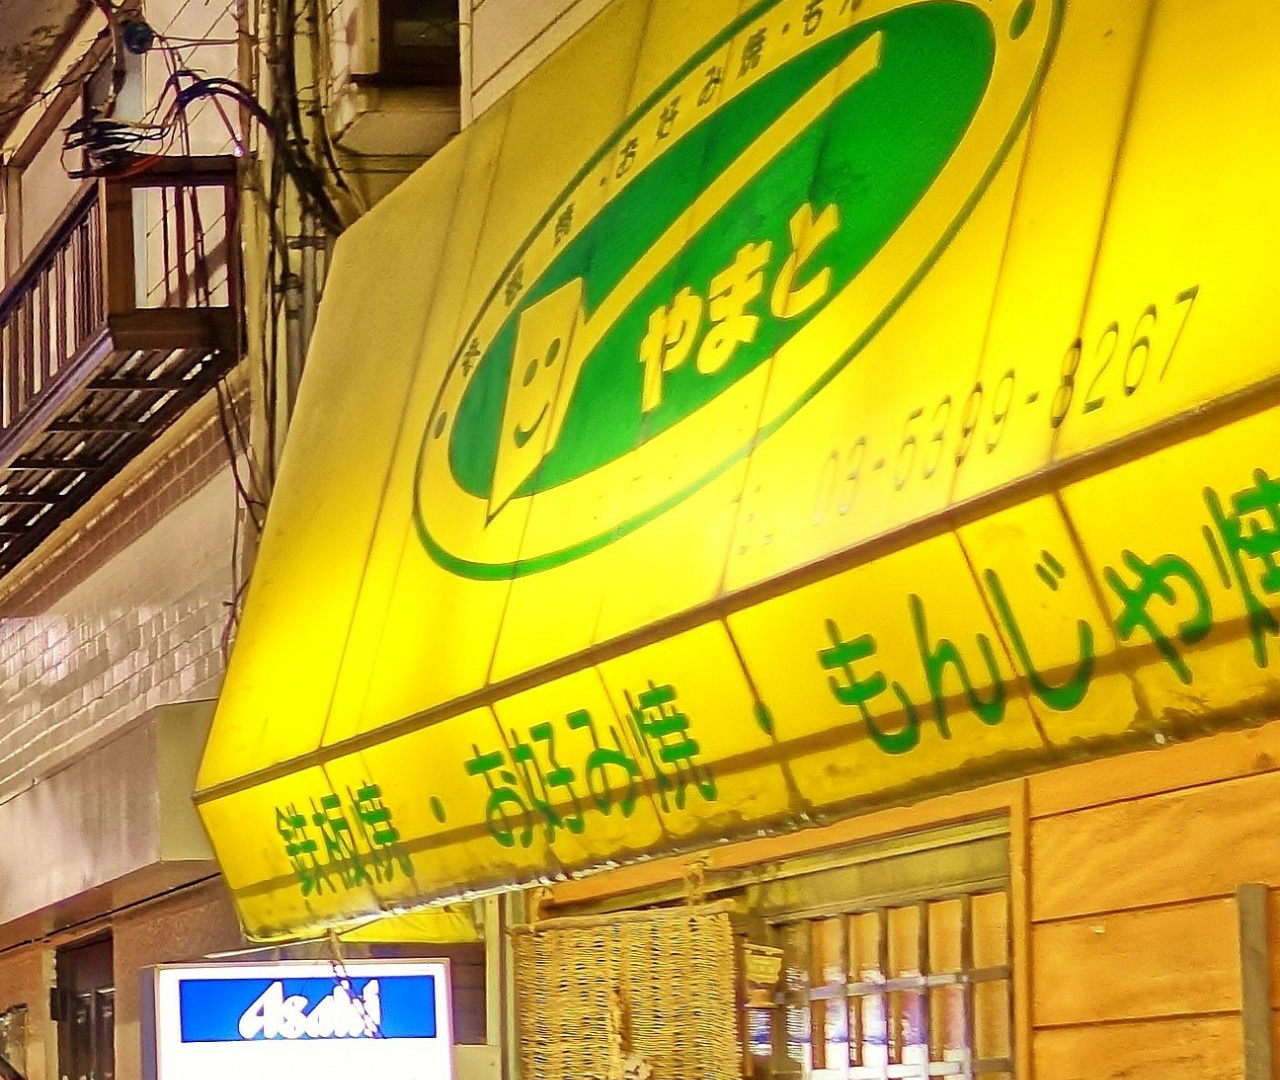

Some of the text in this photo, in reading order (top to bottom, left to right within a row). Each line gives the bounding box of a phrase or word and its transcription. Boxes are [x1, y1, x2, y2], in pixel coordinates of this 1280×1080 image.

[639, 202, 839, 413] やまと
[812, 284, 1200, 526] 03-5399-8267
[238, 978, 381, 1039] Asahi
